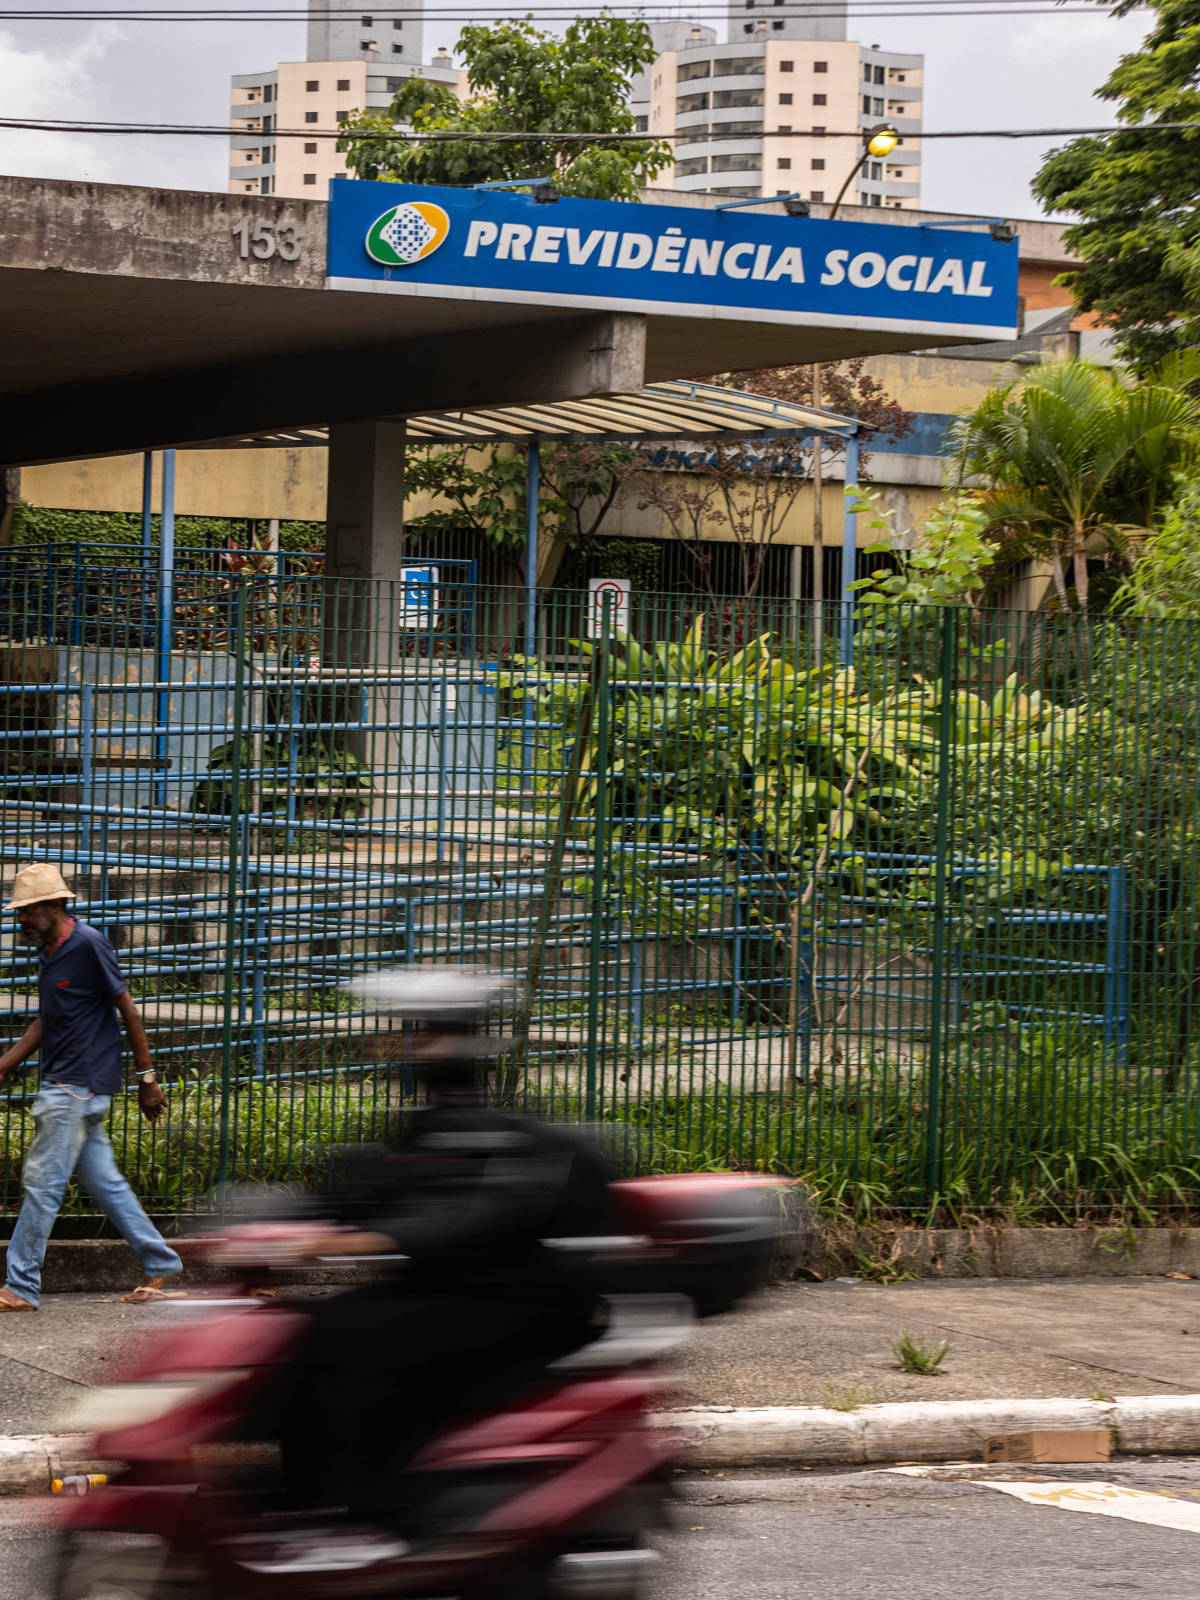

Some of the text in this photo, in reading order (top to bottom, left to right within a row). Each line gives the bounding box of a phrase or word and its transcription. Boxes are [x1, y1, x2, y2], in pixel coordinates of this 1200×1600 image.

[232, 218, 301, 261] 153
[463, 220, 993, 297] PREVIDÊNCIA SOCIAL
